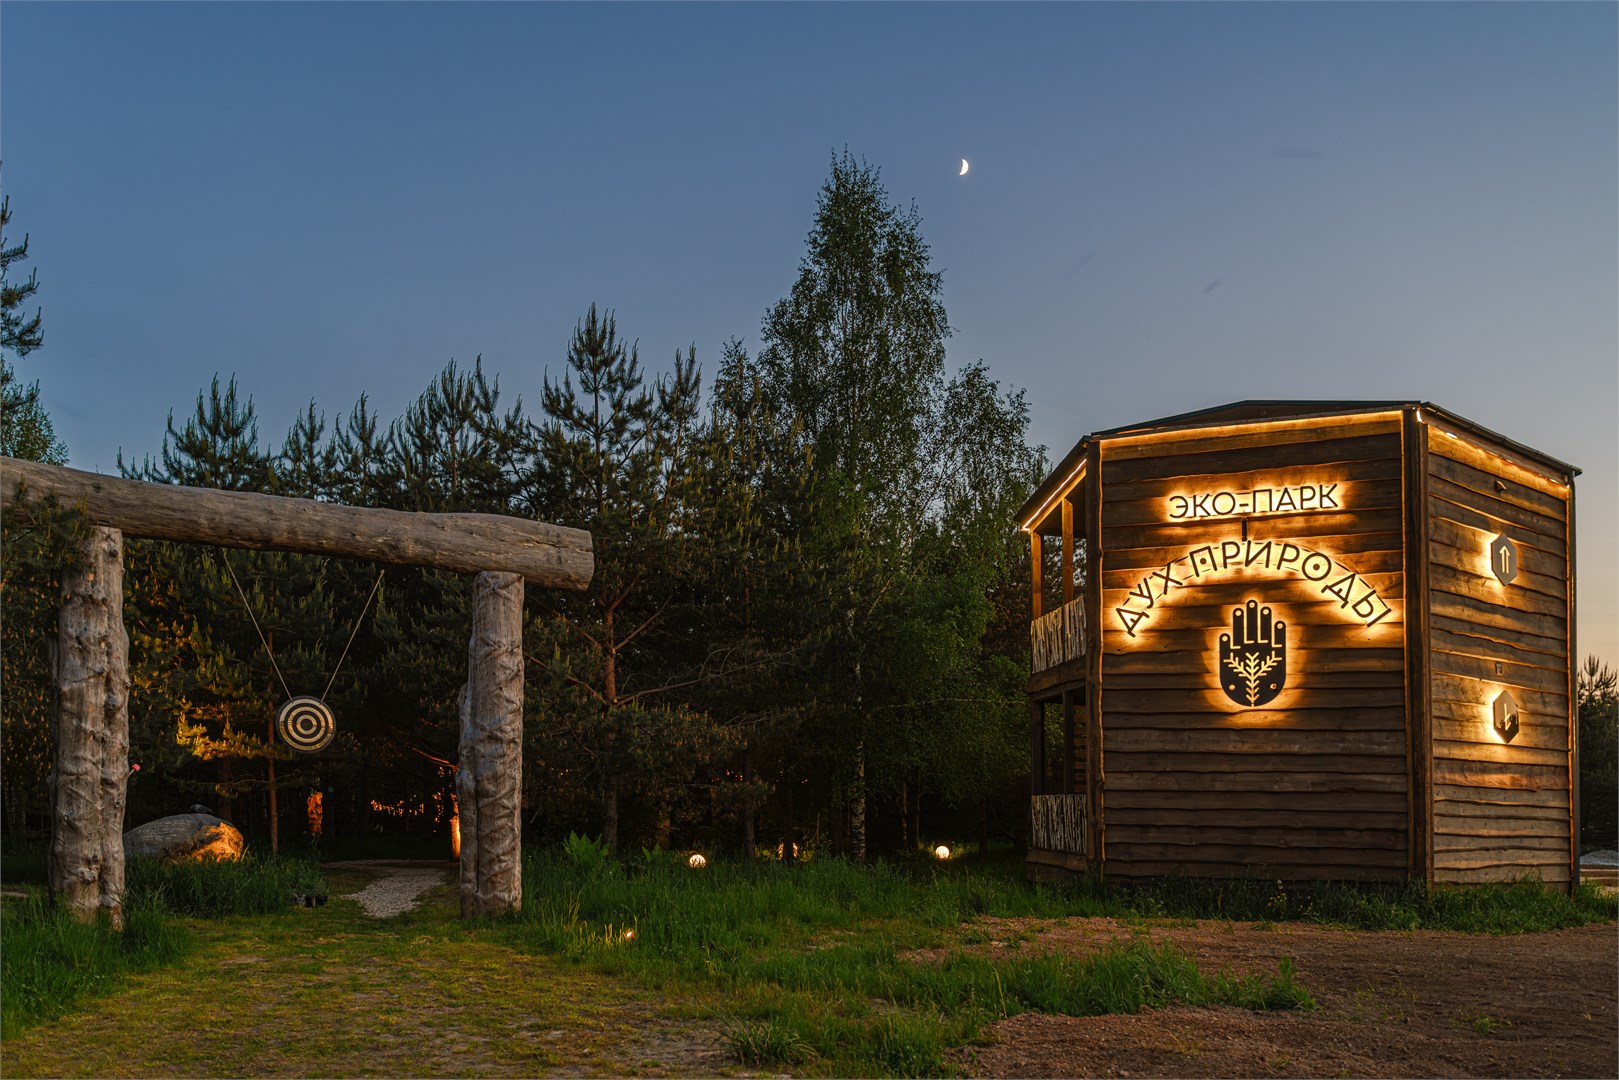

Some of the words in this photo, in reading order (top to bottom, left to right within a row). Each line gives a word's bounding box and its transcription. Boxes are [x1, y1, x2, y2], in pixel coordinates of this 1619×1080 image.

[1169, 483, 1338, 519] ЭКО-ПАРК
[1115, 562, 1183, 637] ДУХ
[1189, 540, 1392, 627] ПРИРОДЫ
